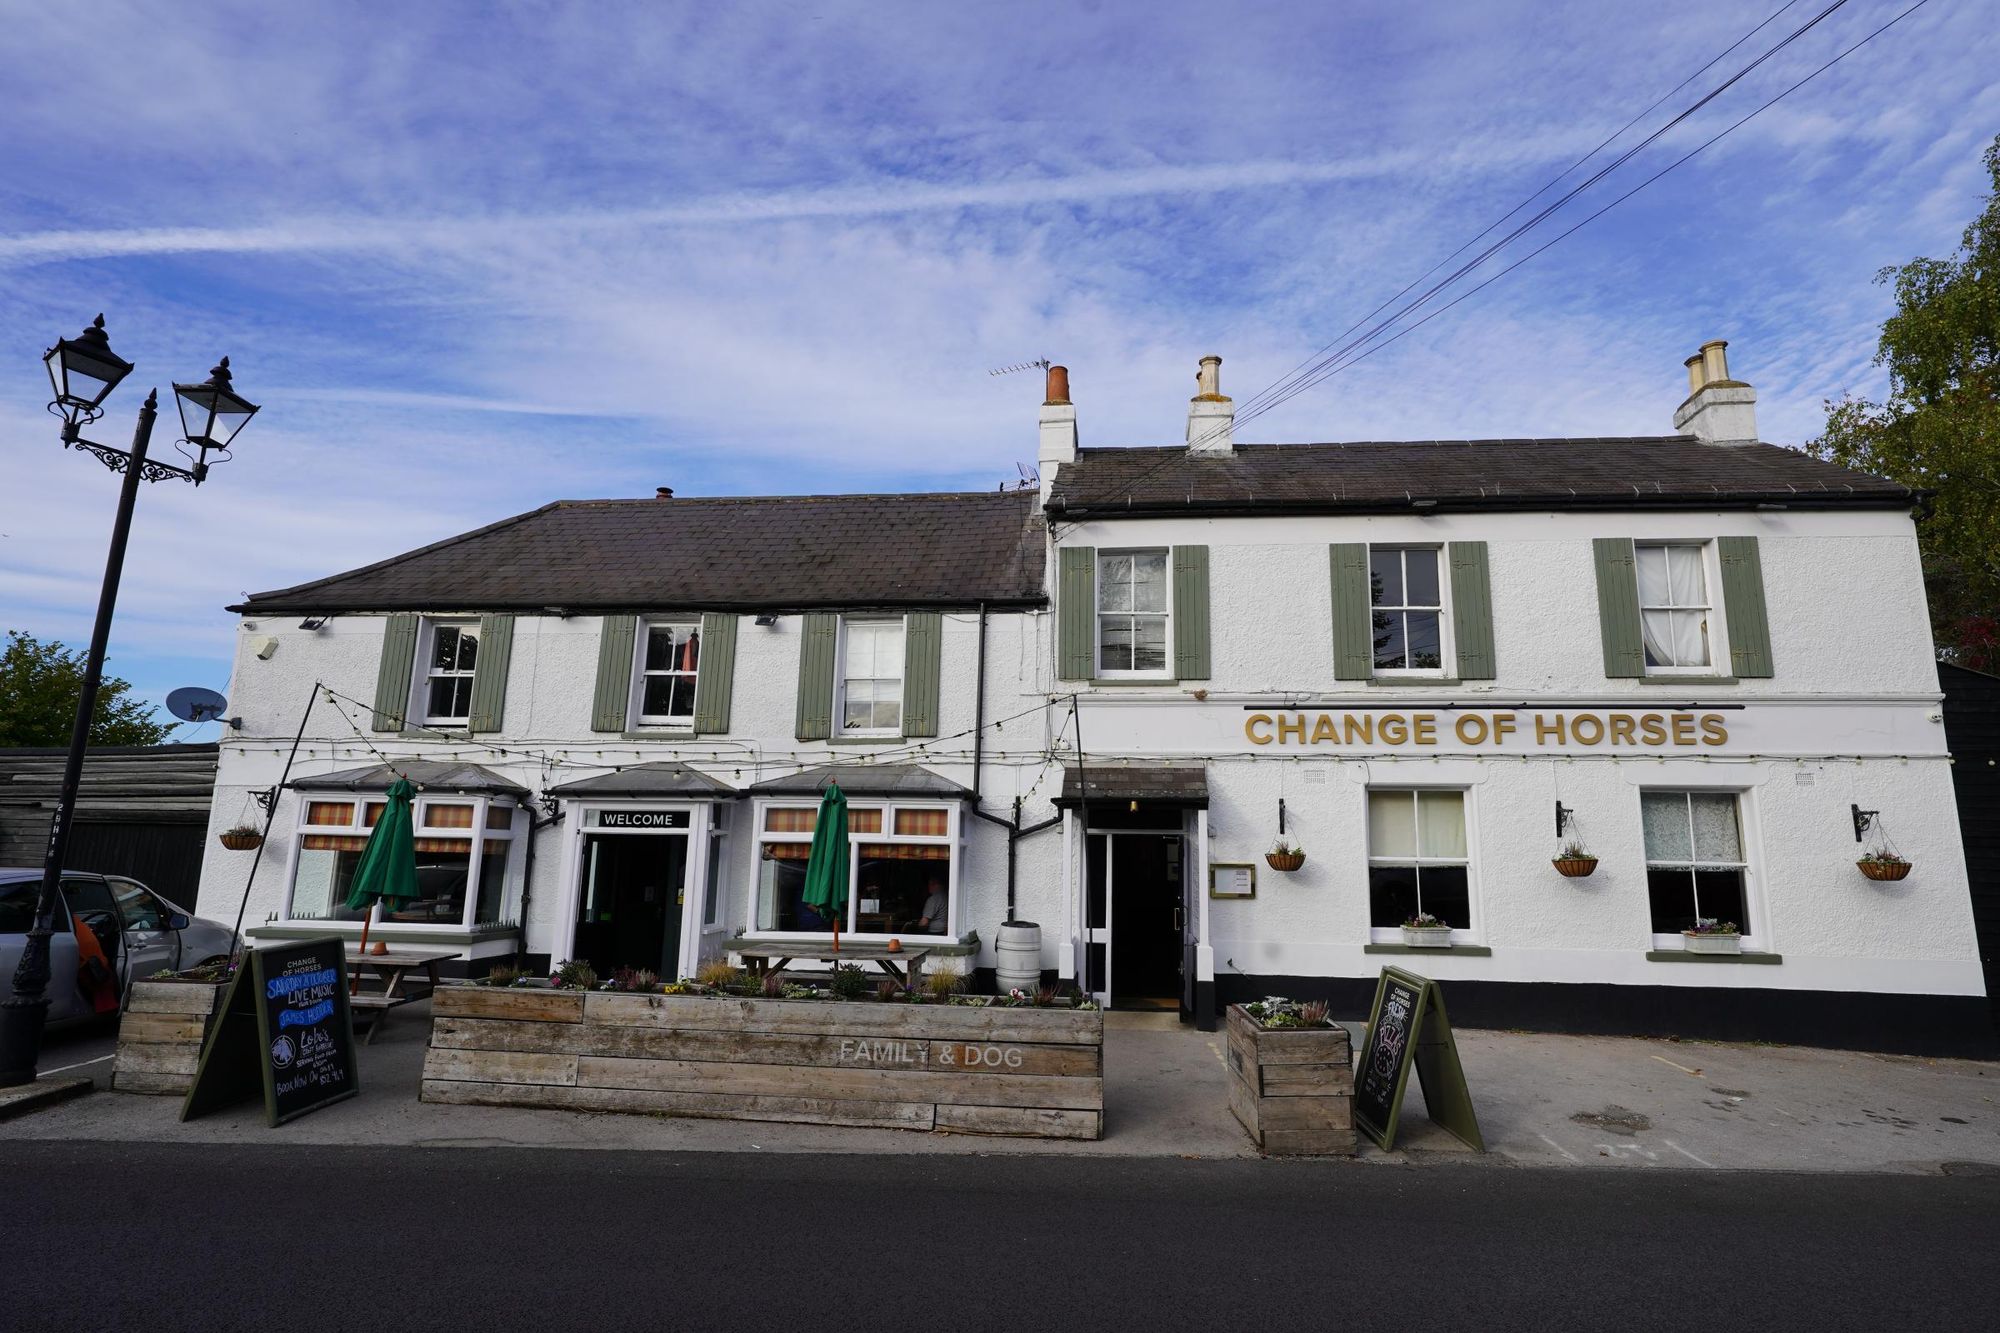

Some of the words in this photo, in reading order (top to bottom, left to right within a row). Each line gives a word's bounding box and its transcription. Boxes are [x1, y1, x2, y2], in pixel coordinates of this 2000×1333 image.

[1244, 714, 1437, 744] CHANGE
[1455, 714, 1517, 745] OF
[1535, 714, 1729, 745] HORSES
[604, 814, 673, 826] WELCOME
[282, 969, 293, 977] OF
[294, 963, 322, 975] HORSES
[287, 956, 317, 969] CHANGE
[267, 976, 302, 999] SATURDAY
[287, 988, 310, 1005] LIVE
[310, 983, 336, 1000] MUSIC
[1394, 987, 1410, 1000] CHANGE
[1396, 996, 1411, 1008] HORSES
[280, 1010, 304, 1026] JAMES
[1388, 1001, 1406, 1020] FRESH
[839, 1040, 928, 1063] FAMILY
[939, 1045, 955, 1065] &
[964, 1046, 1022, 1067] DOG
